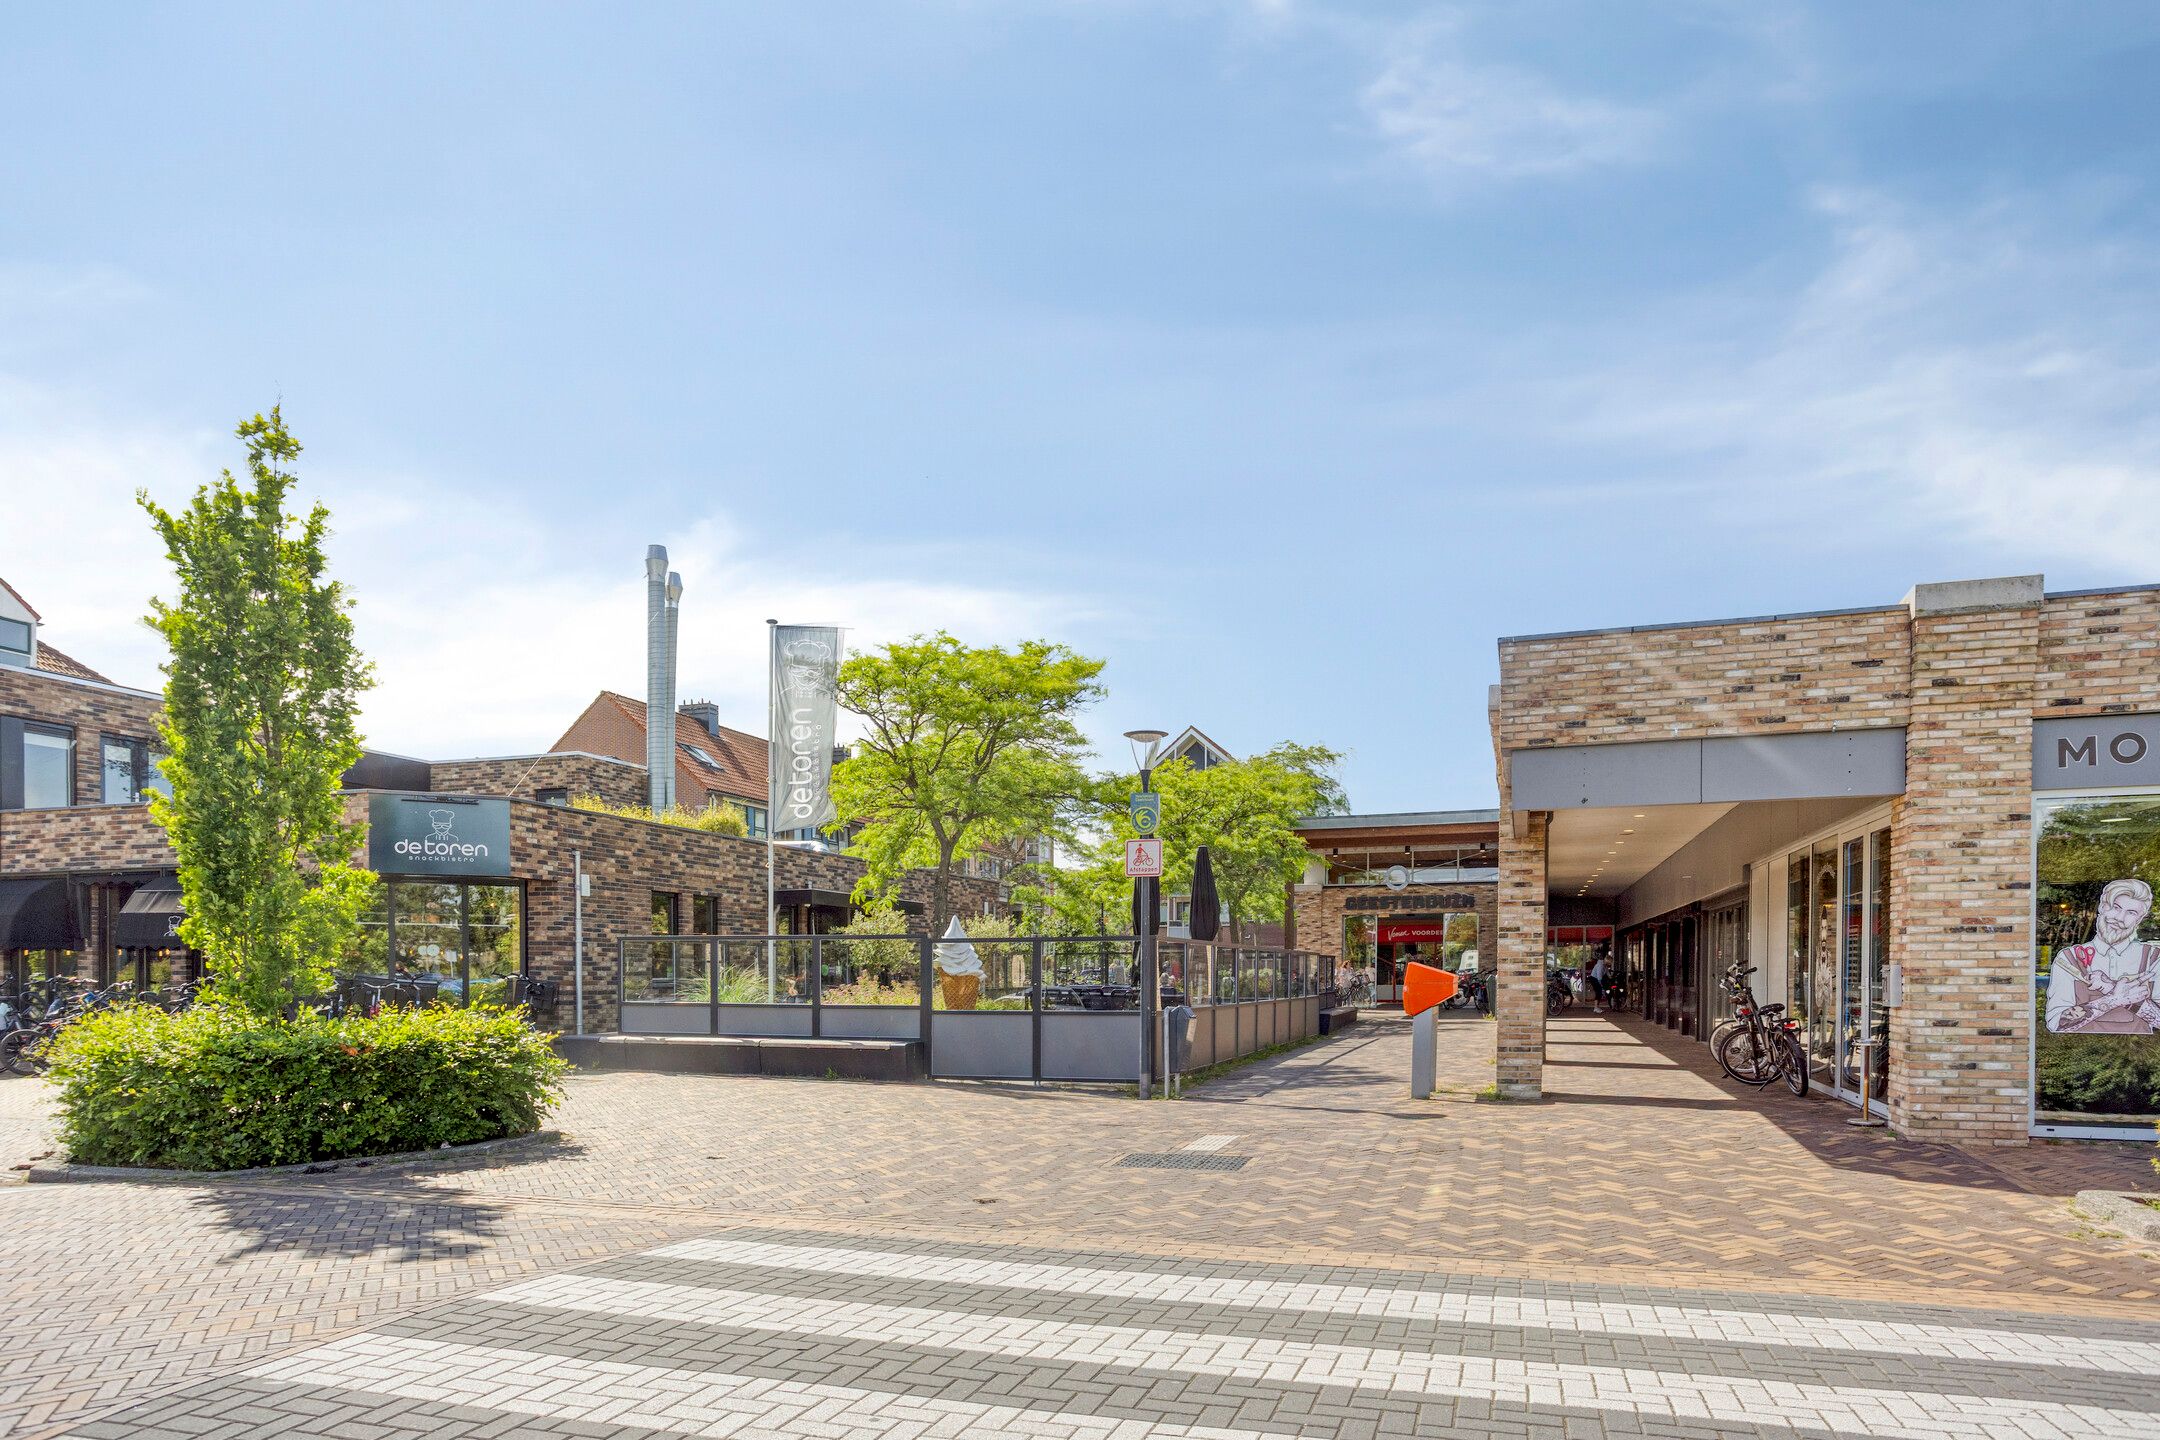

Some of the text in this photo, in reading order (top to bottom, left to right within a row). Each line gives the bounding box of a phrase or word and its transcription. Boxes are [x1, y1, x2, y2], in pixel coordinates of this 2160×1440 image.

[787, 708, 813, 819] de toren
[394, 839, 488, 857] de toren
